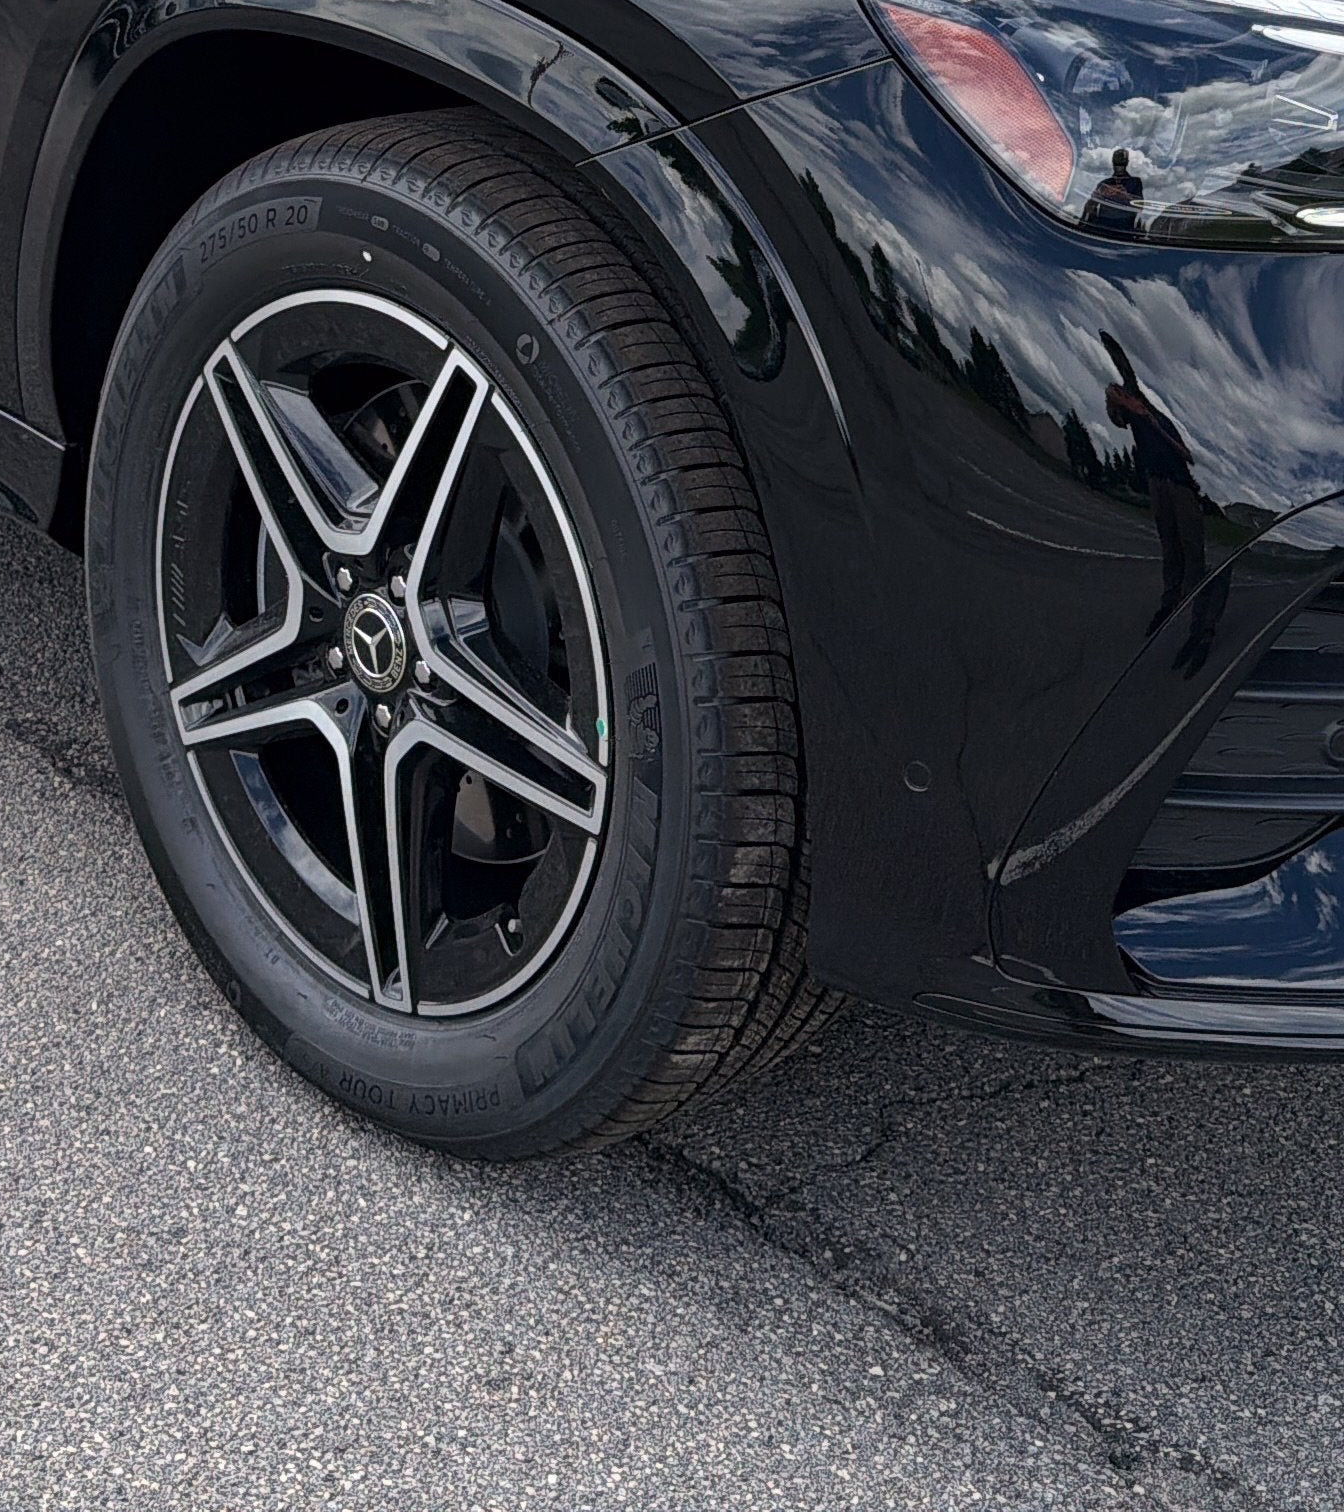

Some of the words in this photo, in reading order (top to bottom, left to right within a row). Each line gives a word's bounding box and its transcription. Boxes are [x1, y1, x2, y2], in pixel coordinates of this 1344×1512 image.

[199, 213, 258, 264] 275/50
[265, 207, 277, 229] R
[284, 204, 308, 226] 20
[344, 599, 364, 656] MERCEDES
[390, 648, 404, 679] BENZ
[519, 775, 658, 1092] MICHELIN
[338, 1069, 396, 1111] TOUR
[408, 1083, 502, 1116] PRIMACY
